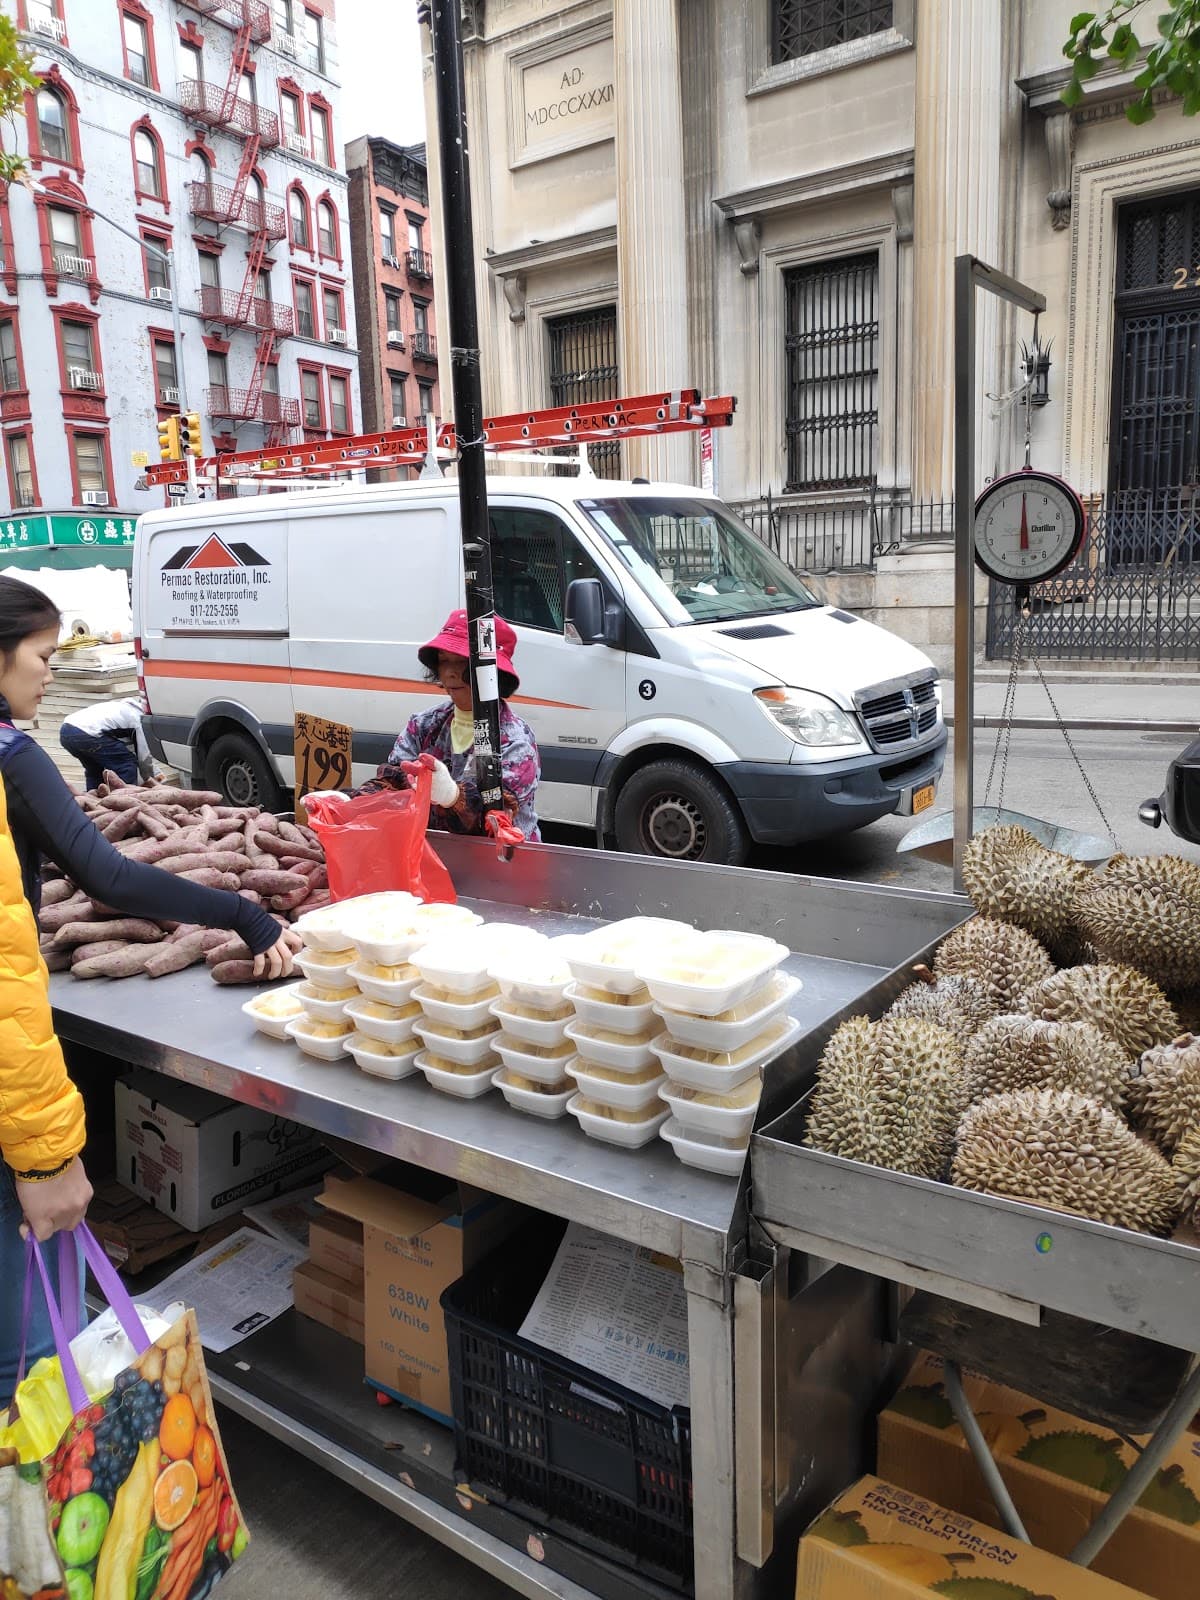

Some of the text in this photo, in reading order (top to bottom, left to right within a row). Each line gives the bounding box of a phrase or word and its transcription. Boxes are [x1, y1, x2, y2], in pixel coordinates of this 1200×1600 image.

[161, 568, 271, 587] Permac Restoration, Inc.
[172, 588, 258, 602] Roofing & Waterproofing
[190, 604, 239, 617] 917-225-2556
[388, 1283, 430, 1312] 638W
[389, 1305, 430, 1334] White
[861, 1499, 1013, 1566] THAI GOLDEN PILLOW
[864, 1491, 1019, 1561] FROZEN DURIAN
